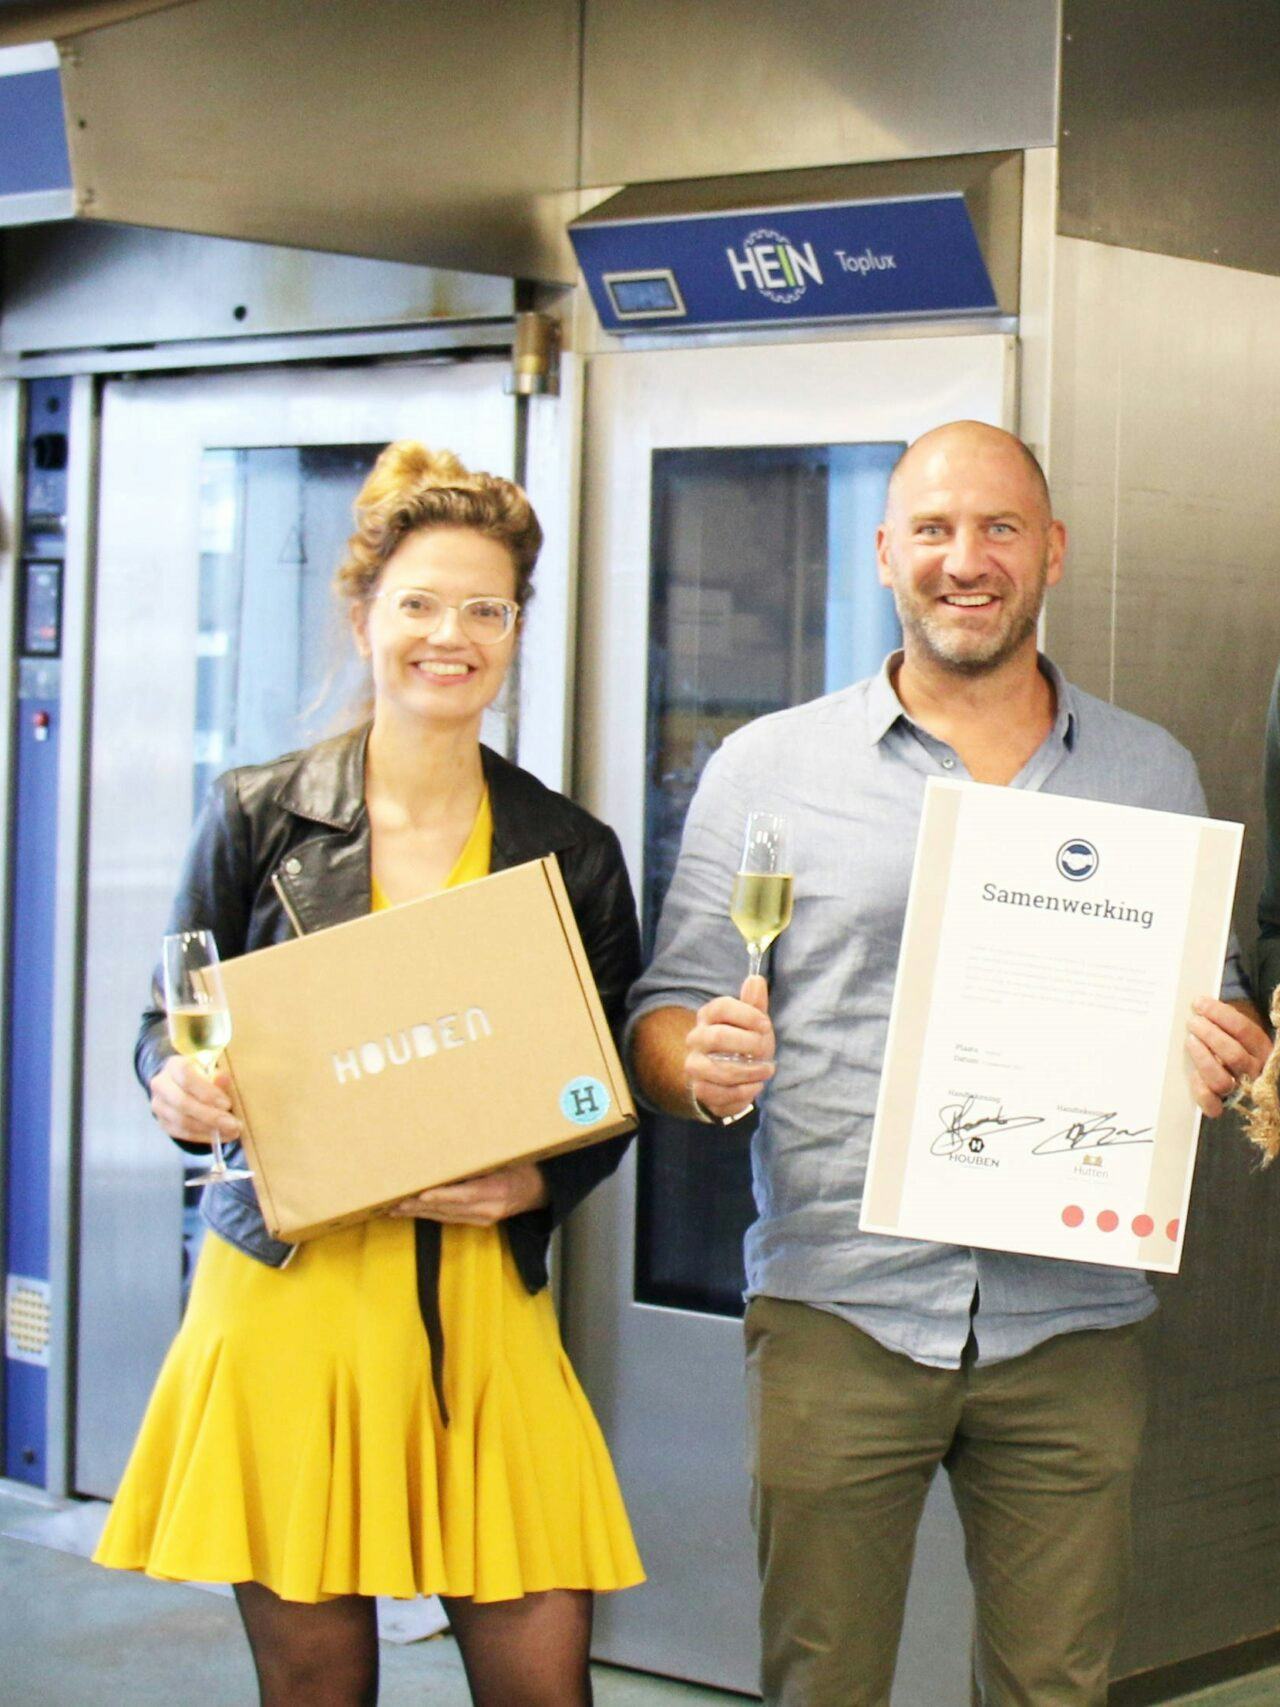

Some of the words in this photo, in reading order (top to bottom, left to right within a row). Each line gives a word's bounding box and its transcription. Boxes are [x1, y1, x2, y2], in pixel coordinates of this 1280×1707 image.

[727, 242, 824, 291] HEIN
[834, 248, 897, 276] Toplux
[982, 882, 1154, 930] Samenwerking
[331, 1006, 493, 1085] HOUBEN
[570, 1085, 599, 1116] H
[948, 1152, 1000, 1168] HOUBEN
